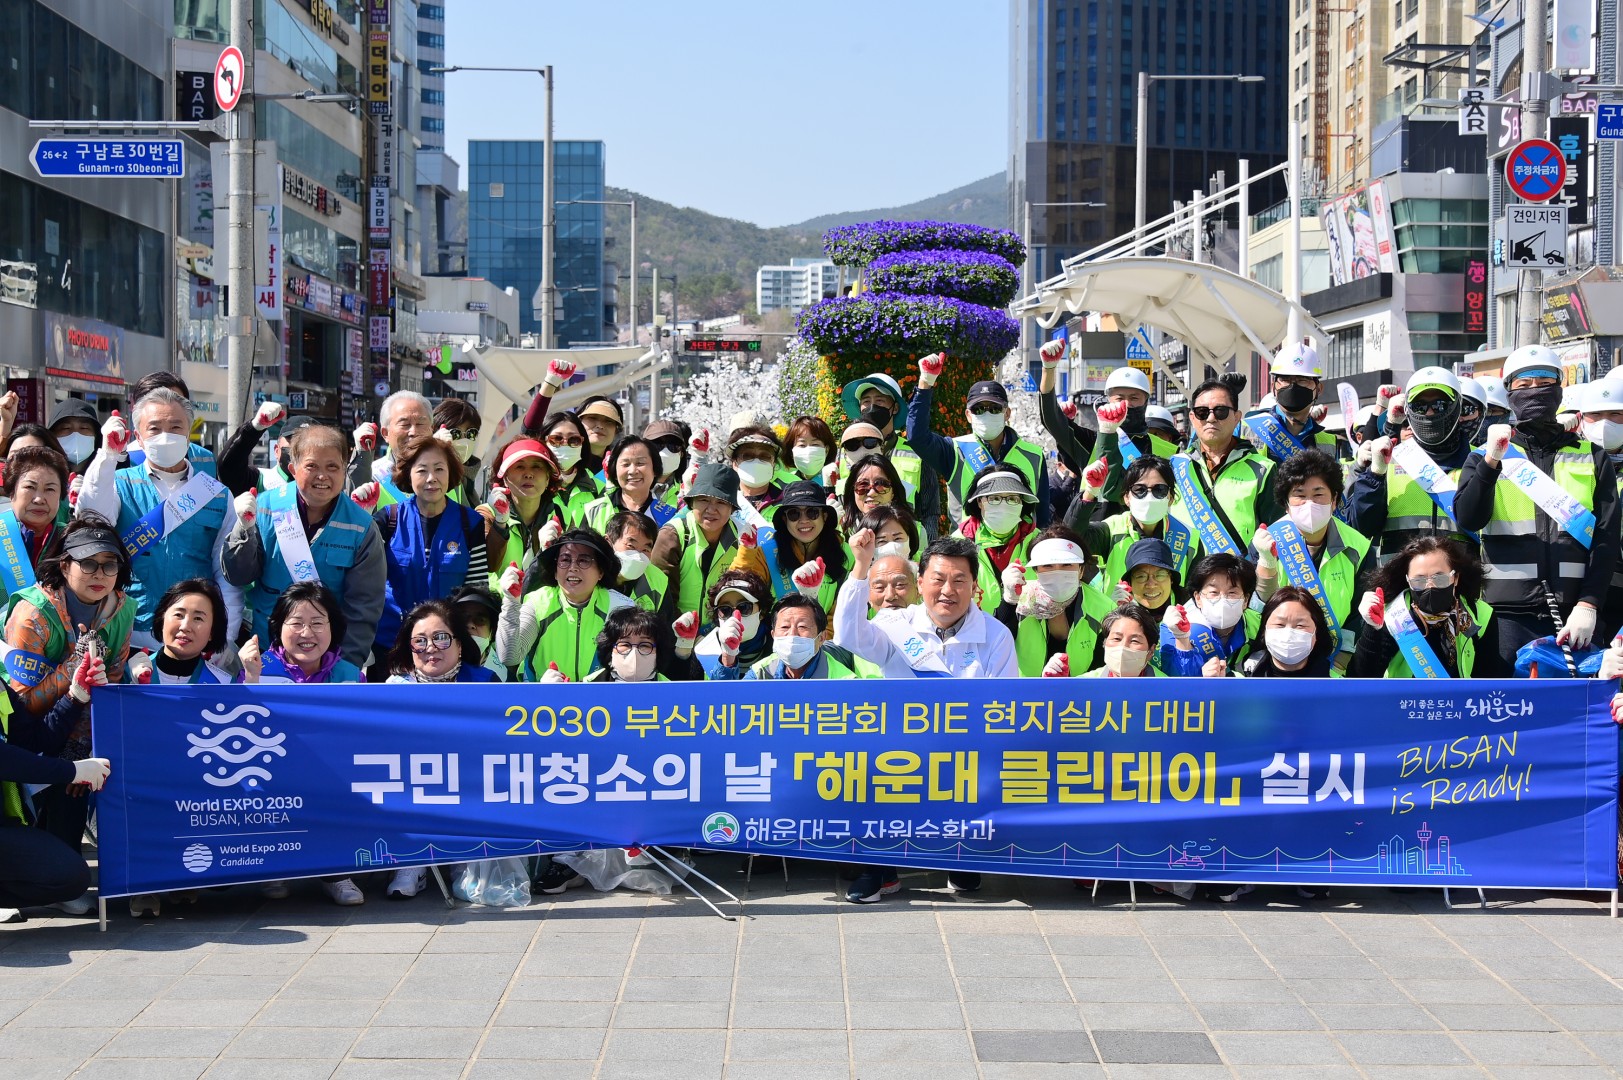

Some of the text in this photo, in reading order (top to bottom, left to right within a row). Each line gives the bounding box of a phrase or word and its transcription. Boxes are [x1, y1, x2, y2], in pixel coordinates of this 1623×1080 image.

[372, 46, 388, 101] 더타이
[192, 76, 205, 118] BAR
[1466, 91, 1485, 132] BAR
[1562, 100, 1597, 112] BAR
[1602, 107, 1623, 124] 구
[76, 144, 125, 161] 구남로
[78, 164, 179, 175] Gunam-ro 30beon-gil
[1514, 166, 1558, 176] 주정차금지
[376, 189, 384, 226] 노래타운
[1514, 210, 1561, 224] 견인 지역
[68, 328, 108, 351] PHOTO DRINK
[1400, 700, 1454, 708] 살기 좋은 도시
[504, 700, 1215, 738] 2030 부산세계박람회 BIE 현지실사 대비
[1408, 711, 1462, 720] 오고 싶은 도시
[1397, 730, 1518, 778] BUSAN
[351, 753, 460, 804] 구민
[482, 752, 701, 804] 대청소의
[724, 752, 777, 802] 날
[1260, 752, 1366, 805] 실시
[1391, 764, 1532, 815] is Ready!
[175, 796, 303, 812] World EXPO 2030
[190, 812, 290, 826] BUSAN, KOREA
[745, 818, 996, 842] 해운대구 자원순환과
[220, 842, 302, 854] World Expo 2030
[220, 857, 264, 867] Candidate
